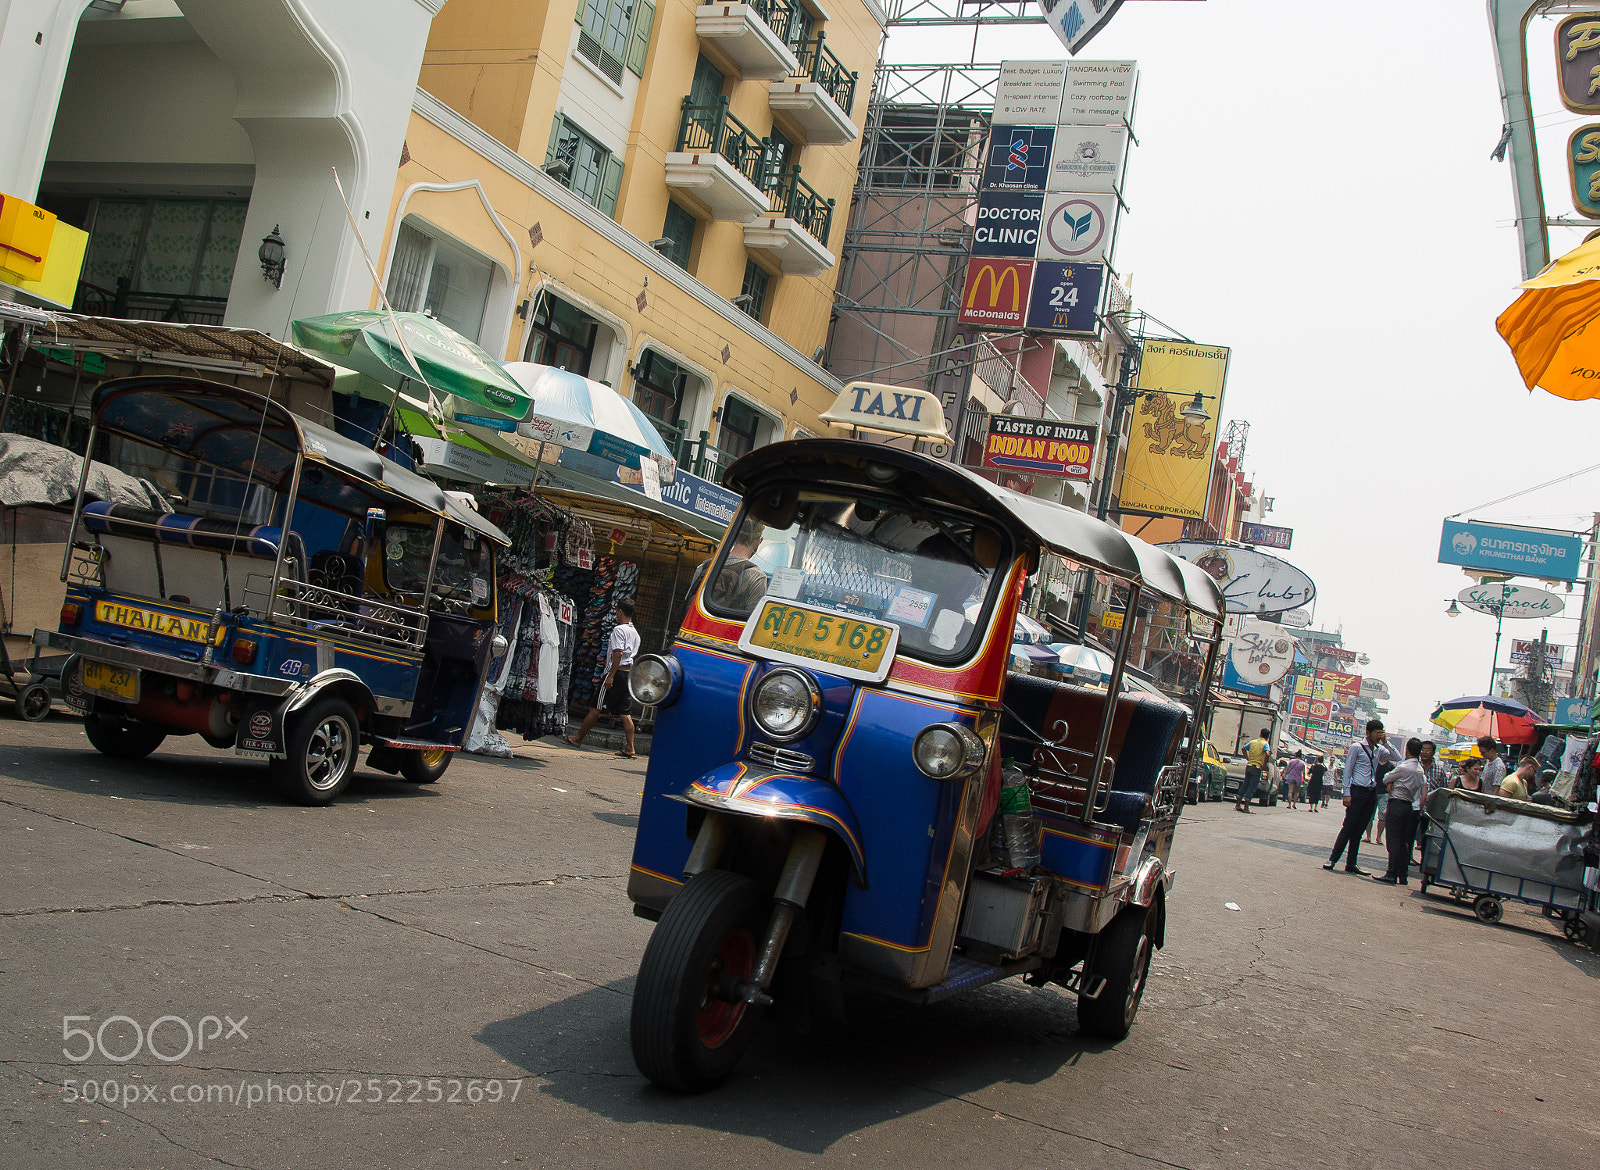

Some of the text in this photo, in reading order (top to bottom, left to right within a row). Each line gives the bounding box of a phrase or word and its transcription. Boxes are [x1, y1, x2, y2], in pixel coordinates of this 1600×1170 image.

[1019, 68, 1041, 76] Budget
[1043, 68, 1064, 76] Luxury
[1073, 80, 1108, 88] Swimming
[978, 207, 1041, 222] DOCTOR
[974, 227, 1038, 245] CLINIC
[1049, 286, 1079, 307] 24
[964, 308, 1020, 321] McDonald's
[426, 334, 477, 364] Chang
[1146, 344, 1165, 354] สิงห์
[495, 390, 515, 403] Chang
[850, 386, 926, 422] TAXI
[531, 423, 555, 435] Tourist
[532, 416, 553, 428] Happy
[996, 420, 1089, 441] TASTE OF INDIA
[988, 435, 1090, 464] INDIAN FOOD
[1121, 500, 1201, 517] SINGHA CORPORATION
[1480, 537, 1567, 558] ธนาคารกรุงไทย
[1479, 549, 1547, 565] KRUNGTHAI BANK
[1222, 572, 1302, 600] Club
[561, 603, 571, 622] 120
[909, 599, 928, 611] 2559
[764, 605, 887, 654] สก 5168
[1237, 632, 1274, 656] Silk
[770, 641, 861, 668] กรุงเทพมหานคร
[1247, 650, 1267, 664] bar
[280, 659, 302, 676] 46
[1362, 681, 1383, 691] Buddy
[1328, 721, 1353, 733] BAG
